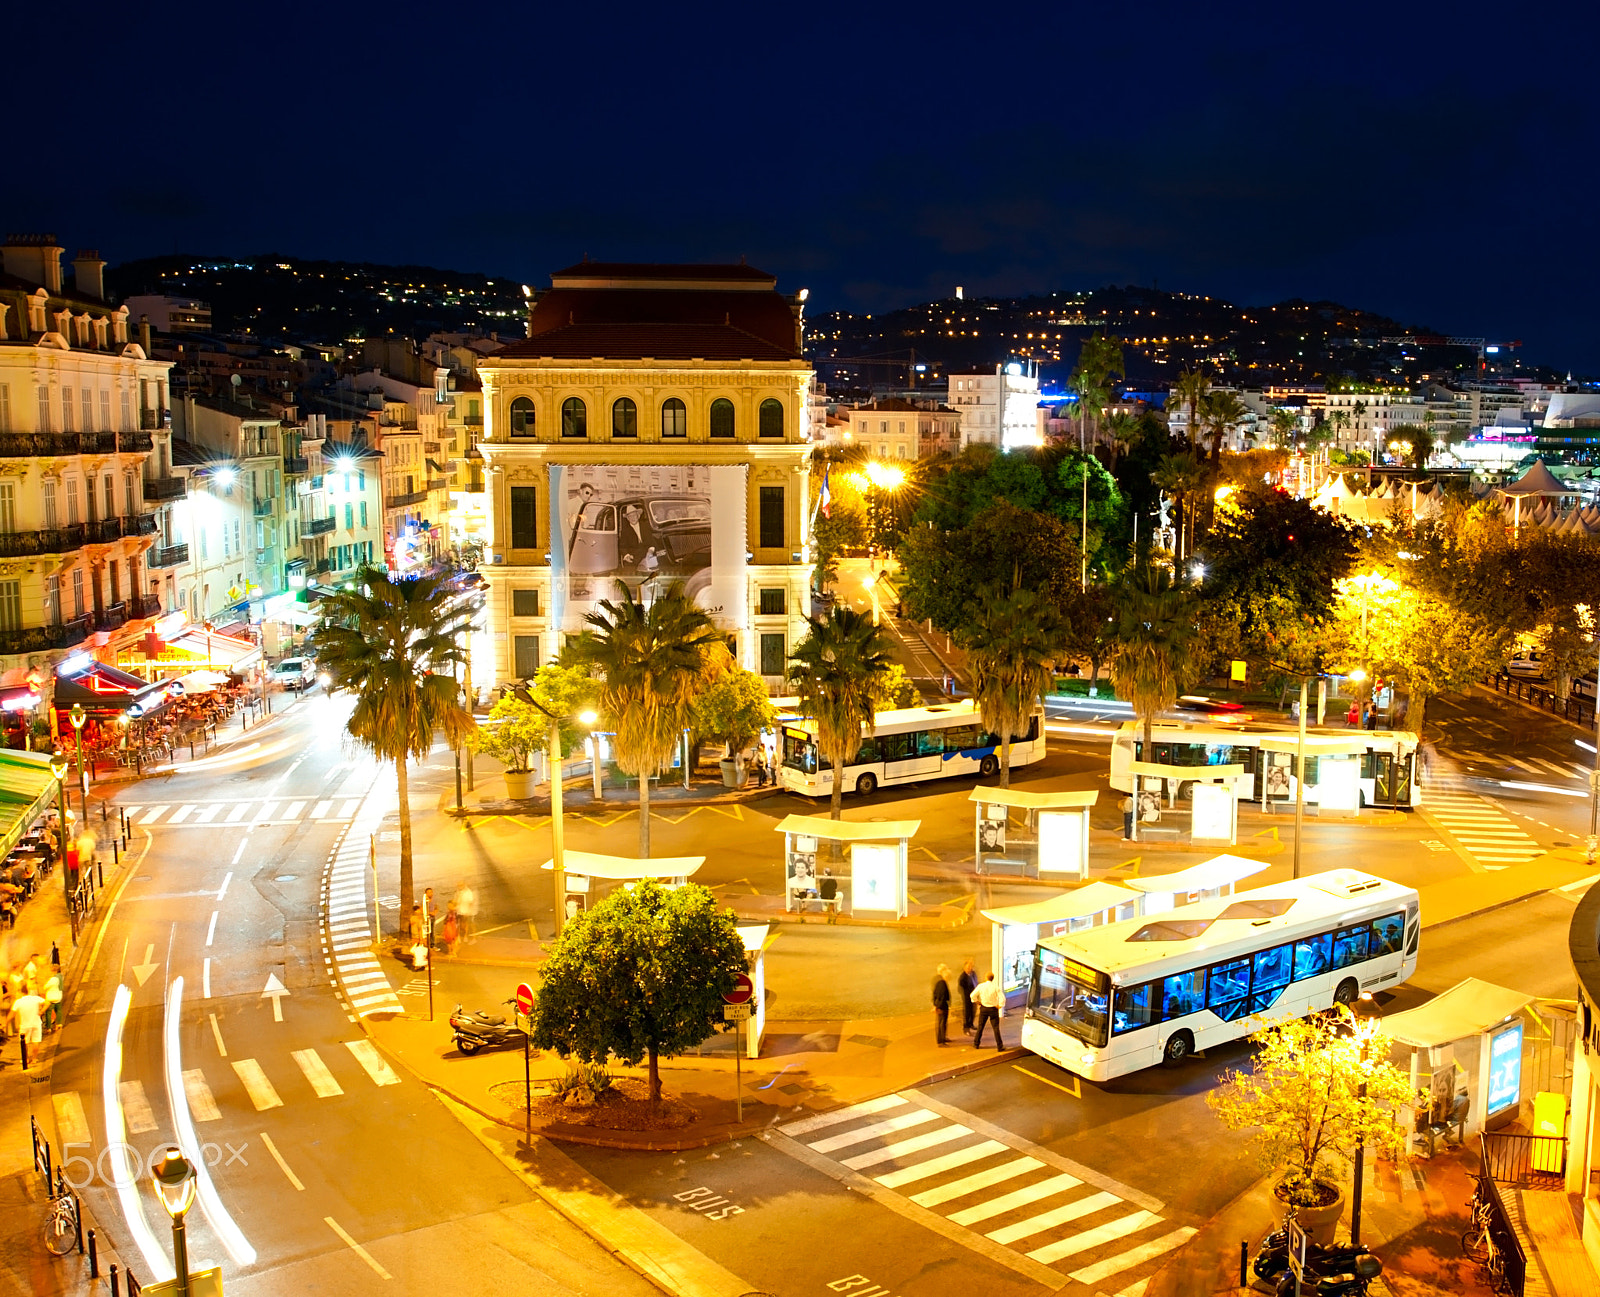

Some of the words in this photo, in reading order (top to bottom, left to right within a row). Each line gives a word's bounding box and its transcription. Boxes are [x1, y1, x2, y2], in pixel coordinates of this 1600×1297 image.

[672, 1186, 746, 1221] BUS
[1292, 1230, 1300, 1252] P
[826, 1274, 892, 1297] BU
